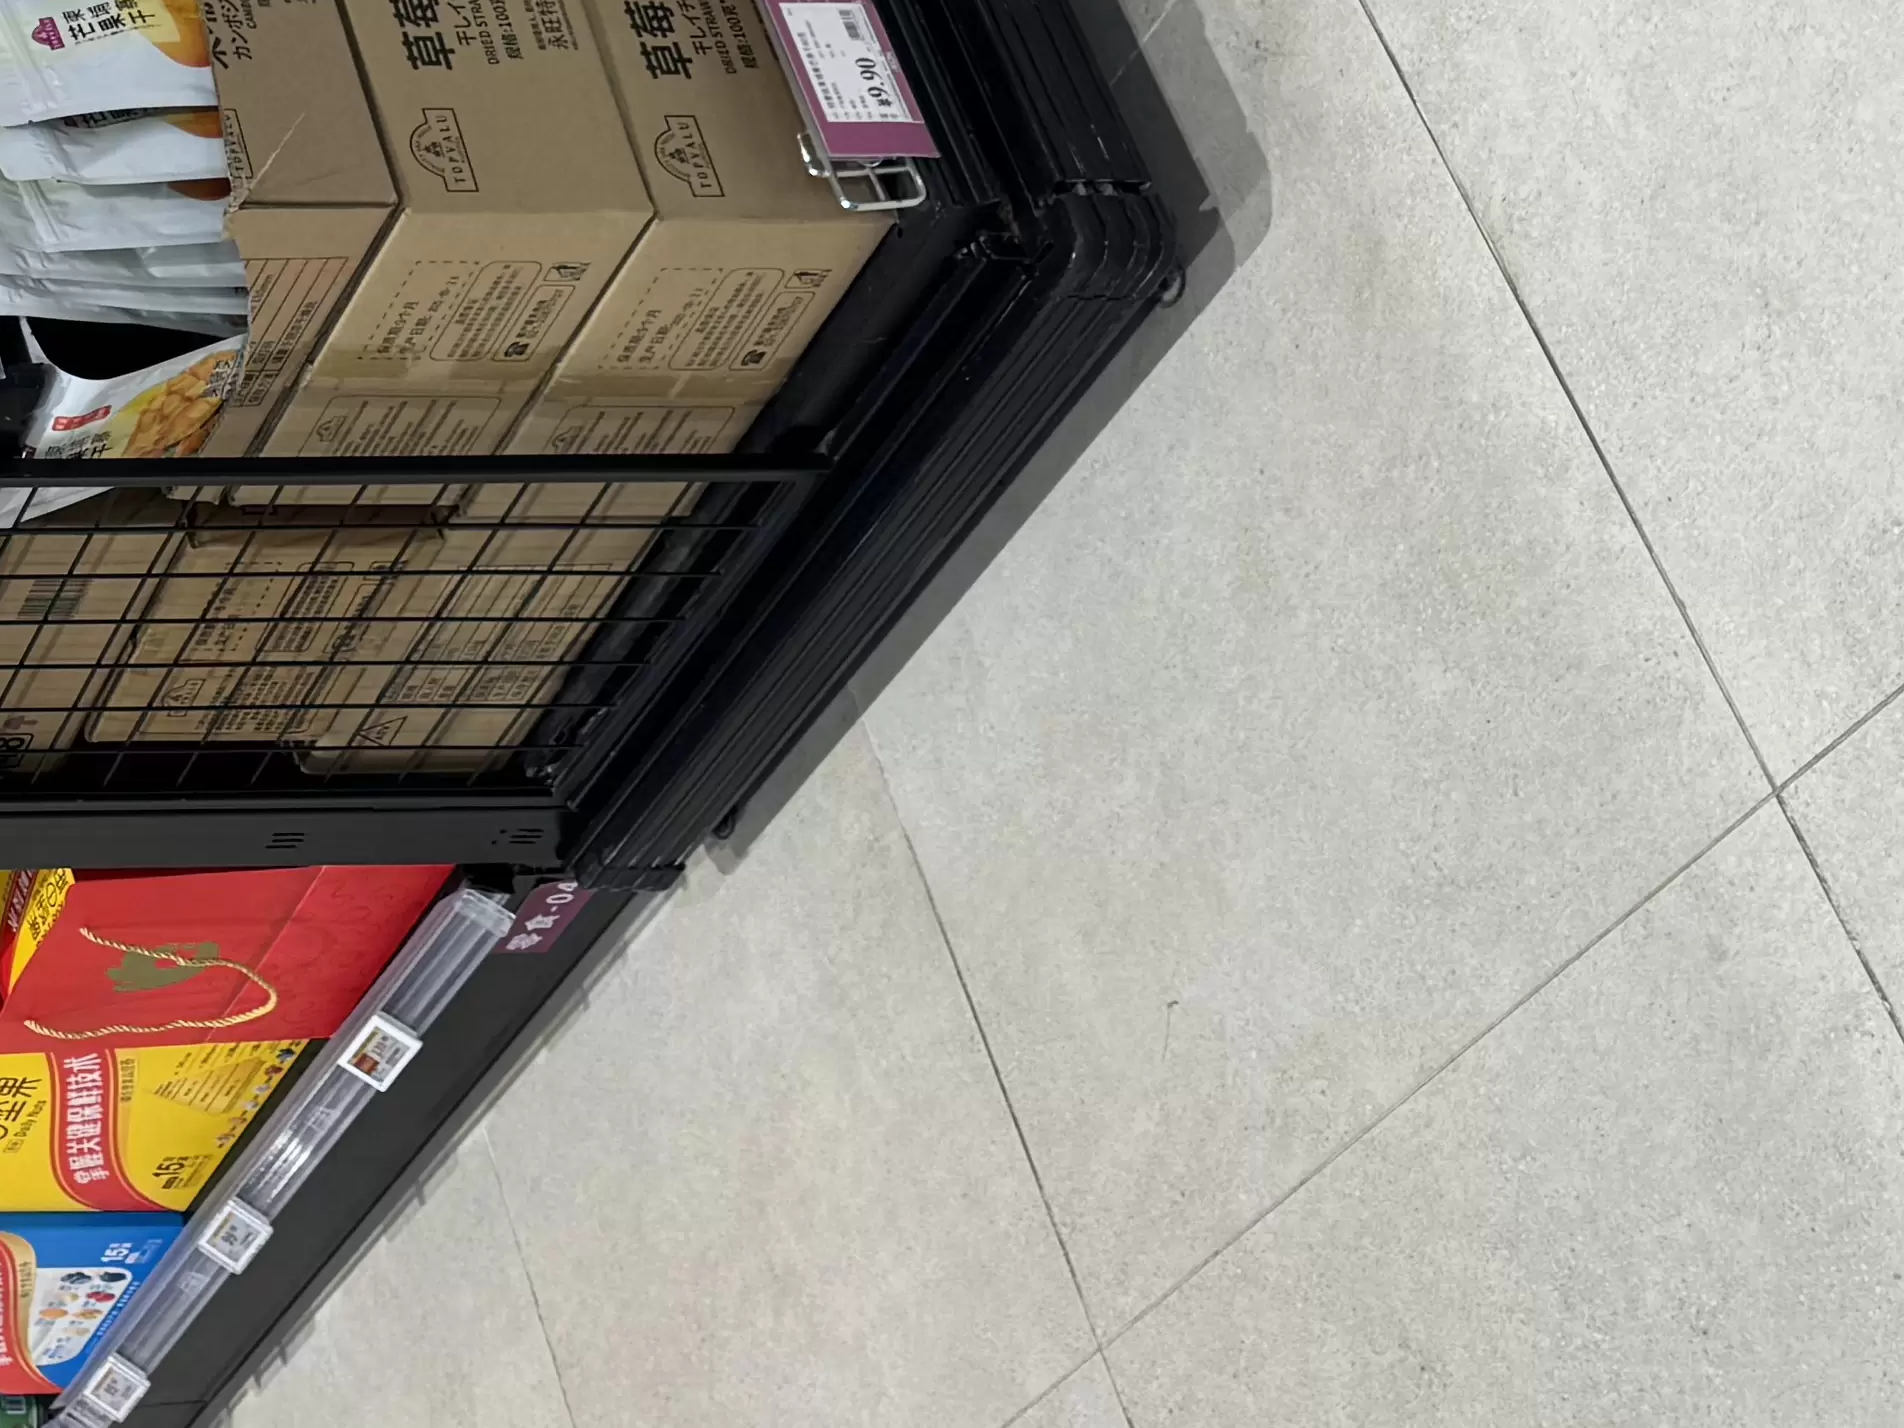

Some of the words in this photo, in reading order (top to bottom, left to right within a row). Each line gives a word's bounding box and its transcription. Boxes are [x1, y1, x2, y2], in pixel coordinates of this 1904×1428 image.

[64, 5, 158, 43] 芒果干
[474, 28, 501, 66] DRIED
[709, 39, 738, 75] DRIED
[433, 113, 470, 187] TOPVALU
[61, 1052, 111, 1186] 掌握关键保鲜技术
